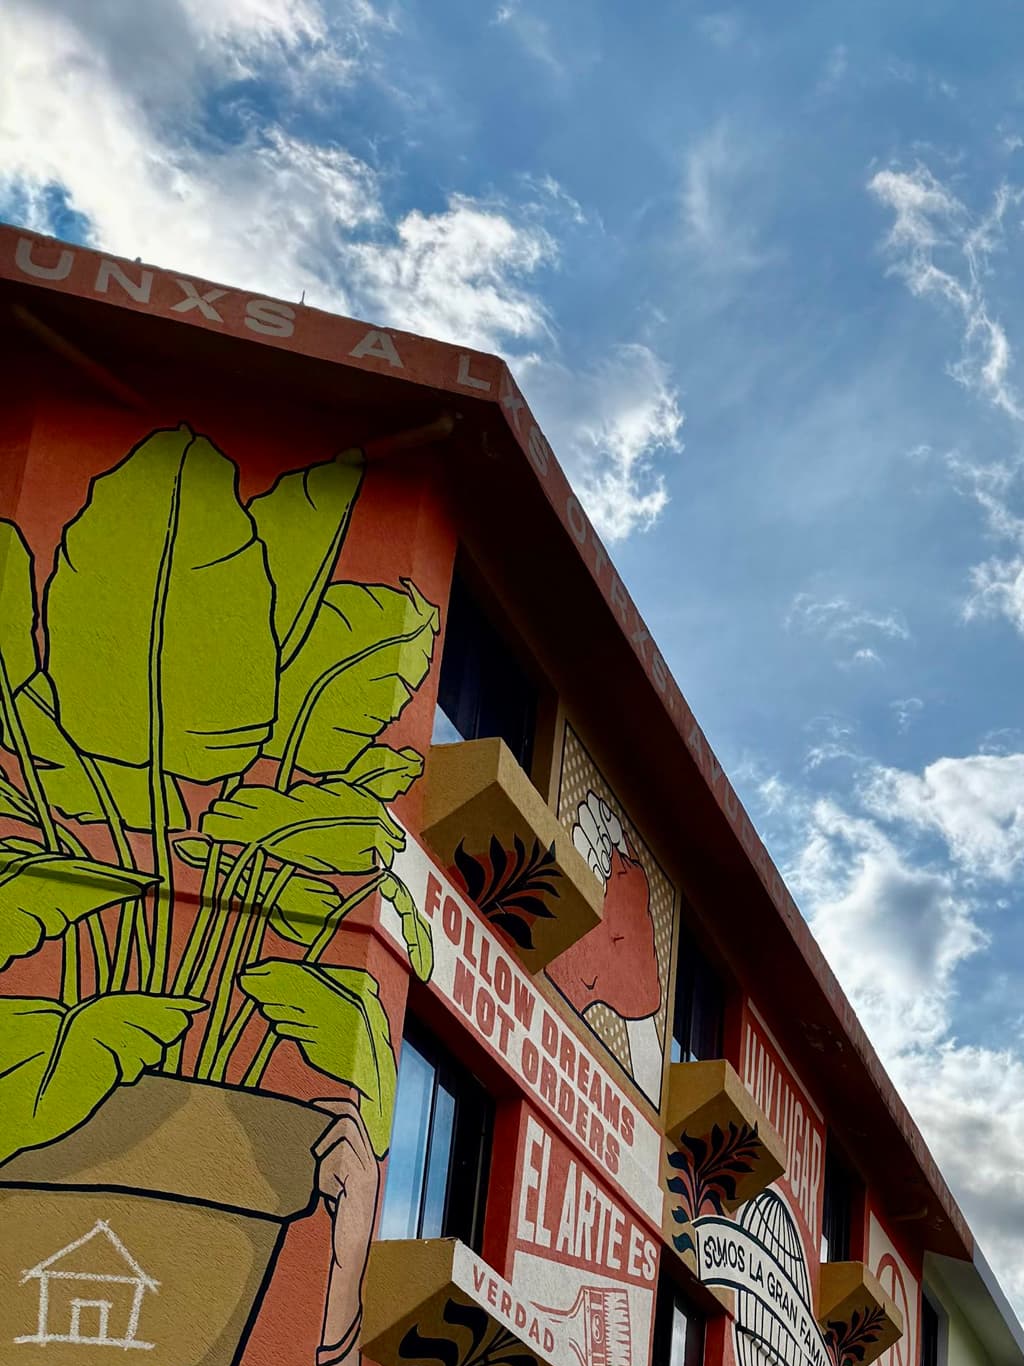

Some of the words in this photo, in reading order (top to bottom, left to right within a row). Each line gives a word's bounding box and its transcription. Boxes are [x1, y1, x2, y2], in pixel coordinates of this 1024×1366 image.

[15, 238, 295, 337] UNXS
[350, 331, 403, 368] A
[425, 871, 535, 1031] FOLLOW
[542, 1009, 635, 1147] DREAMS
[453, 957, 515, 1055] NOT
[521, 1037, 620, 1175] ORDERS
[517, 1115, 551, 1248] EL
[556, 1159, 625, 1270] ARTE
[627, 1224, 657, 1281] ES
[472, 1264, 555, 1353] VERDAD
[704, 1235, 745, 1272] SOMOS
[749, 1252, 764, 1289] LA
[767, 1272, 798, 1328] GRAN
